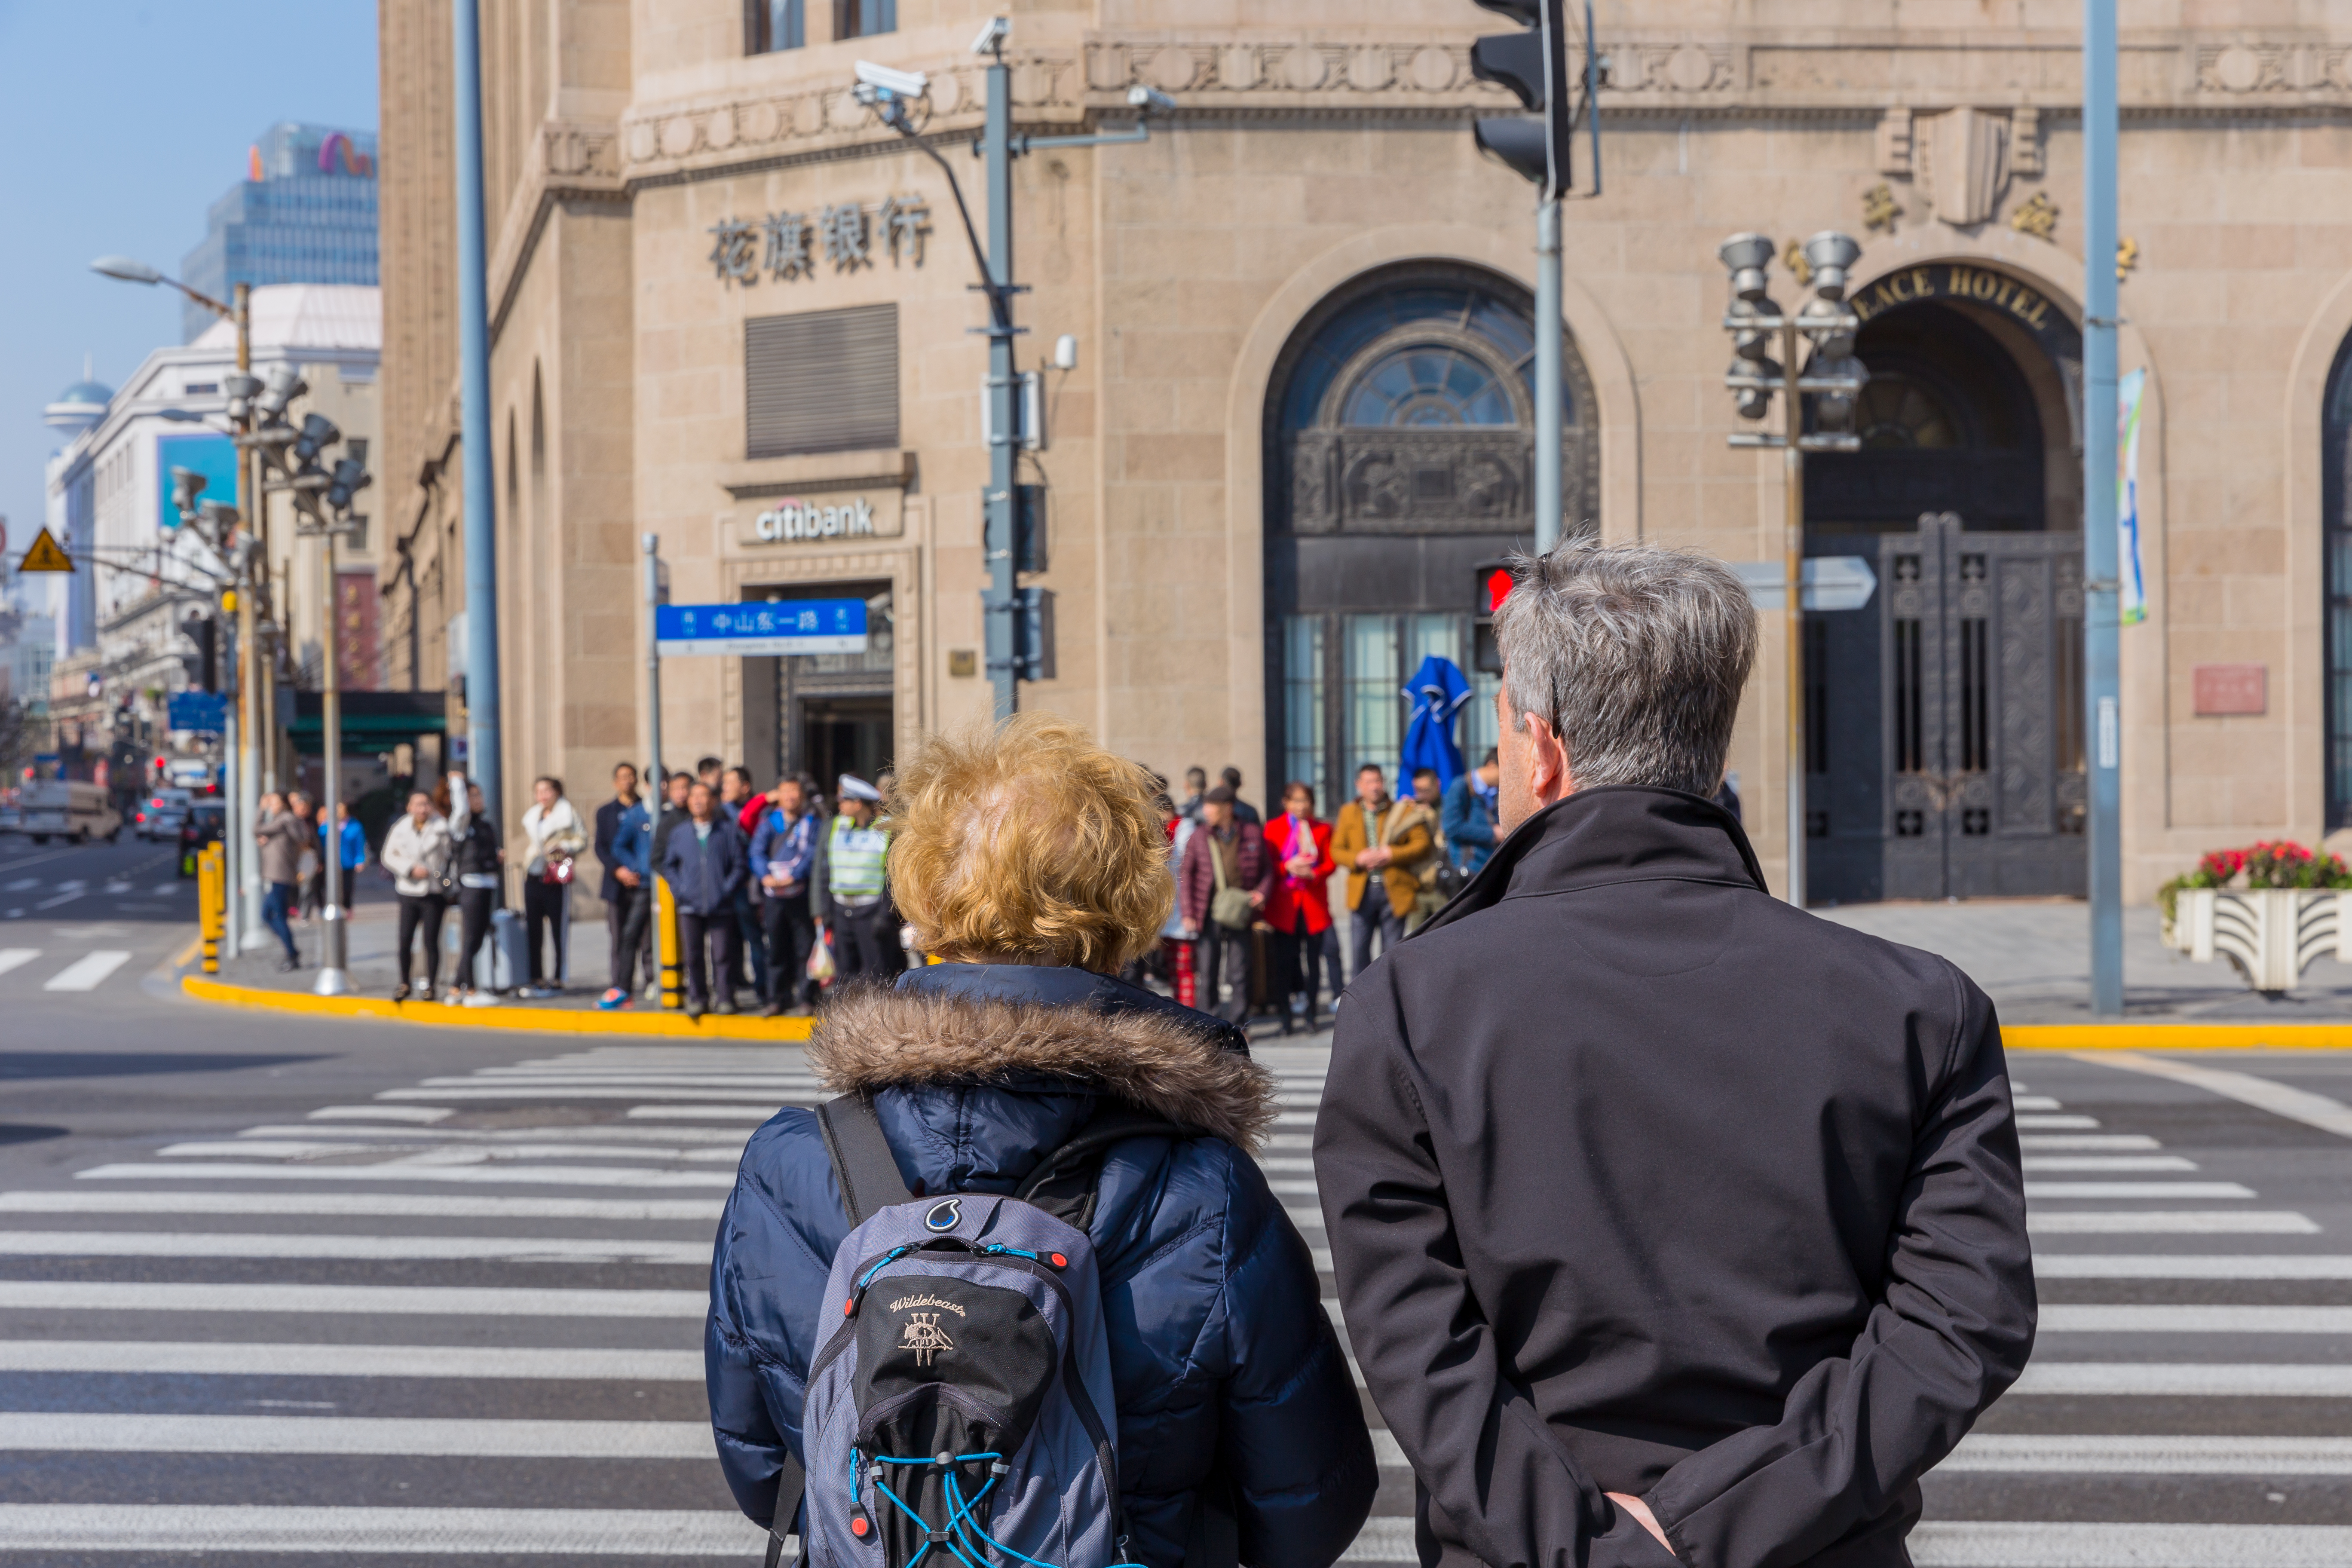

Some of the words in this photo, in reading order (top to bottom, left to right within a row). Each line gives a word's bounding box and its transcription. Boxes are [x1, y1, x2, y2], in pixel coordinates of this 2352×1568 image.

[707, 194, 927, 277] 花旗银行
[1851, 267, 1934, 322] EACE
[1948, 266, 2050, 331] HOTEL
[755, 497, 874, 540] citibank
[931, 1216, 954, 1226] HYDRO
